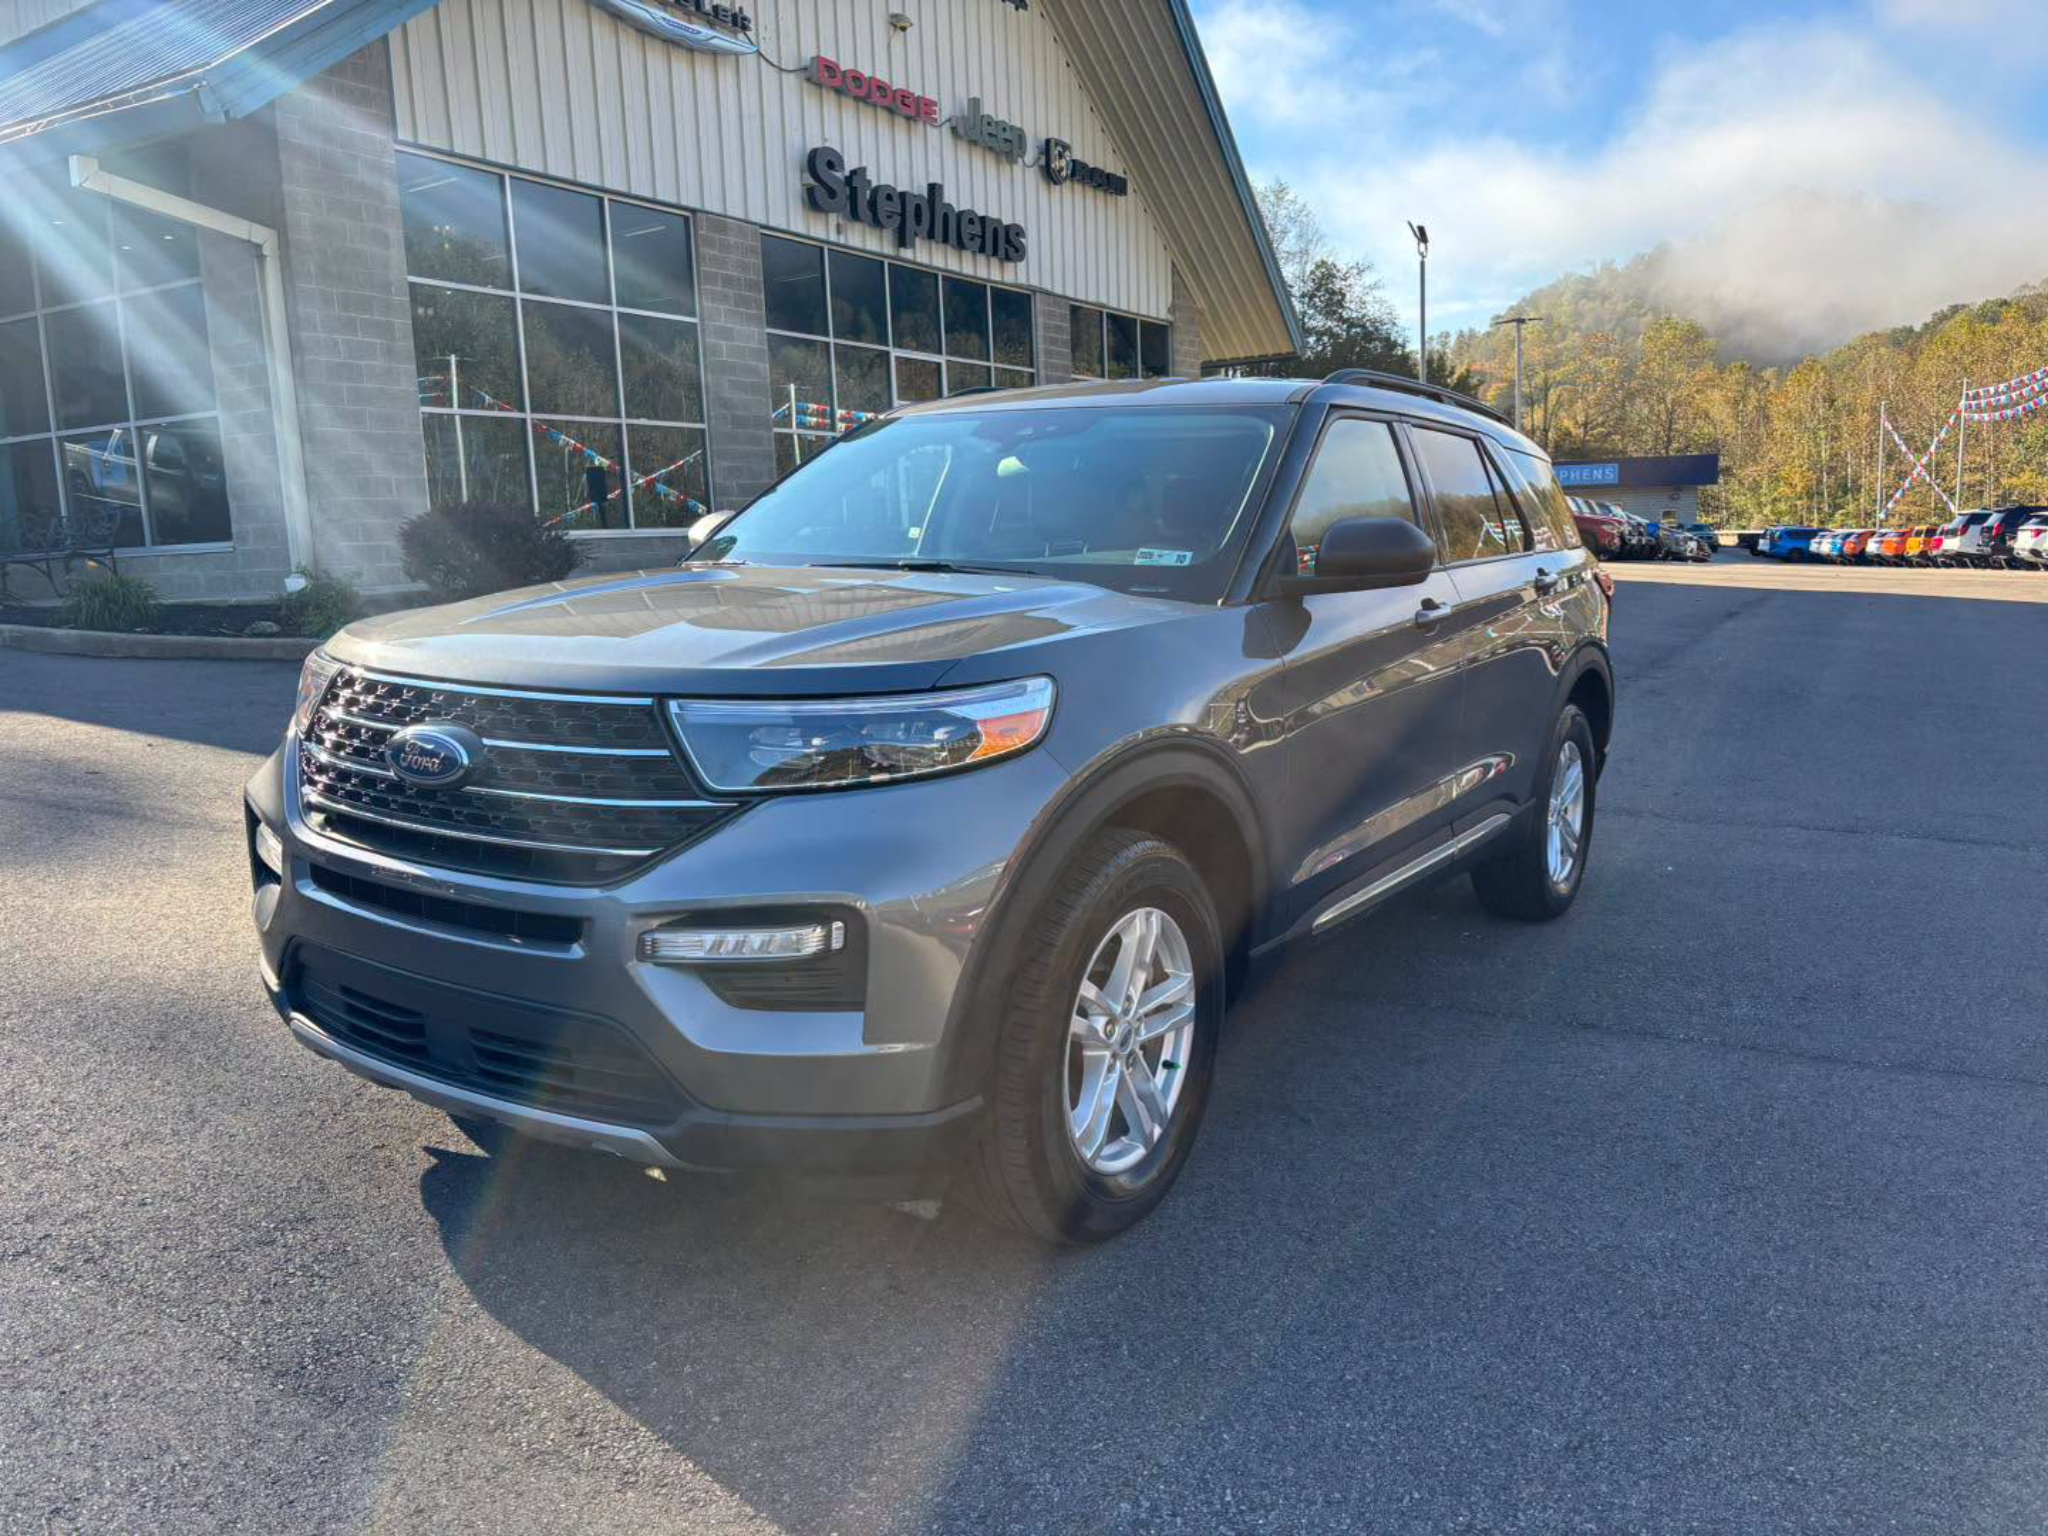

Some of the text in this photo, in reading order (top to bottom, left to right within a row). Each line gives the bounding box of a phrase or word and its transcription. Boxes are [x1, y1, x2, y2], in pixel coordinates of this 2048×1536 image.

[807, 56, 938, 126] DODGE
[951, 97, 1026, 163] Jeep
[804, 146, 1026, 262] Stephens
[400, 740, 446, 772] Ford
